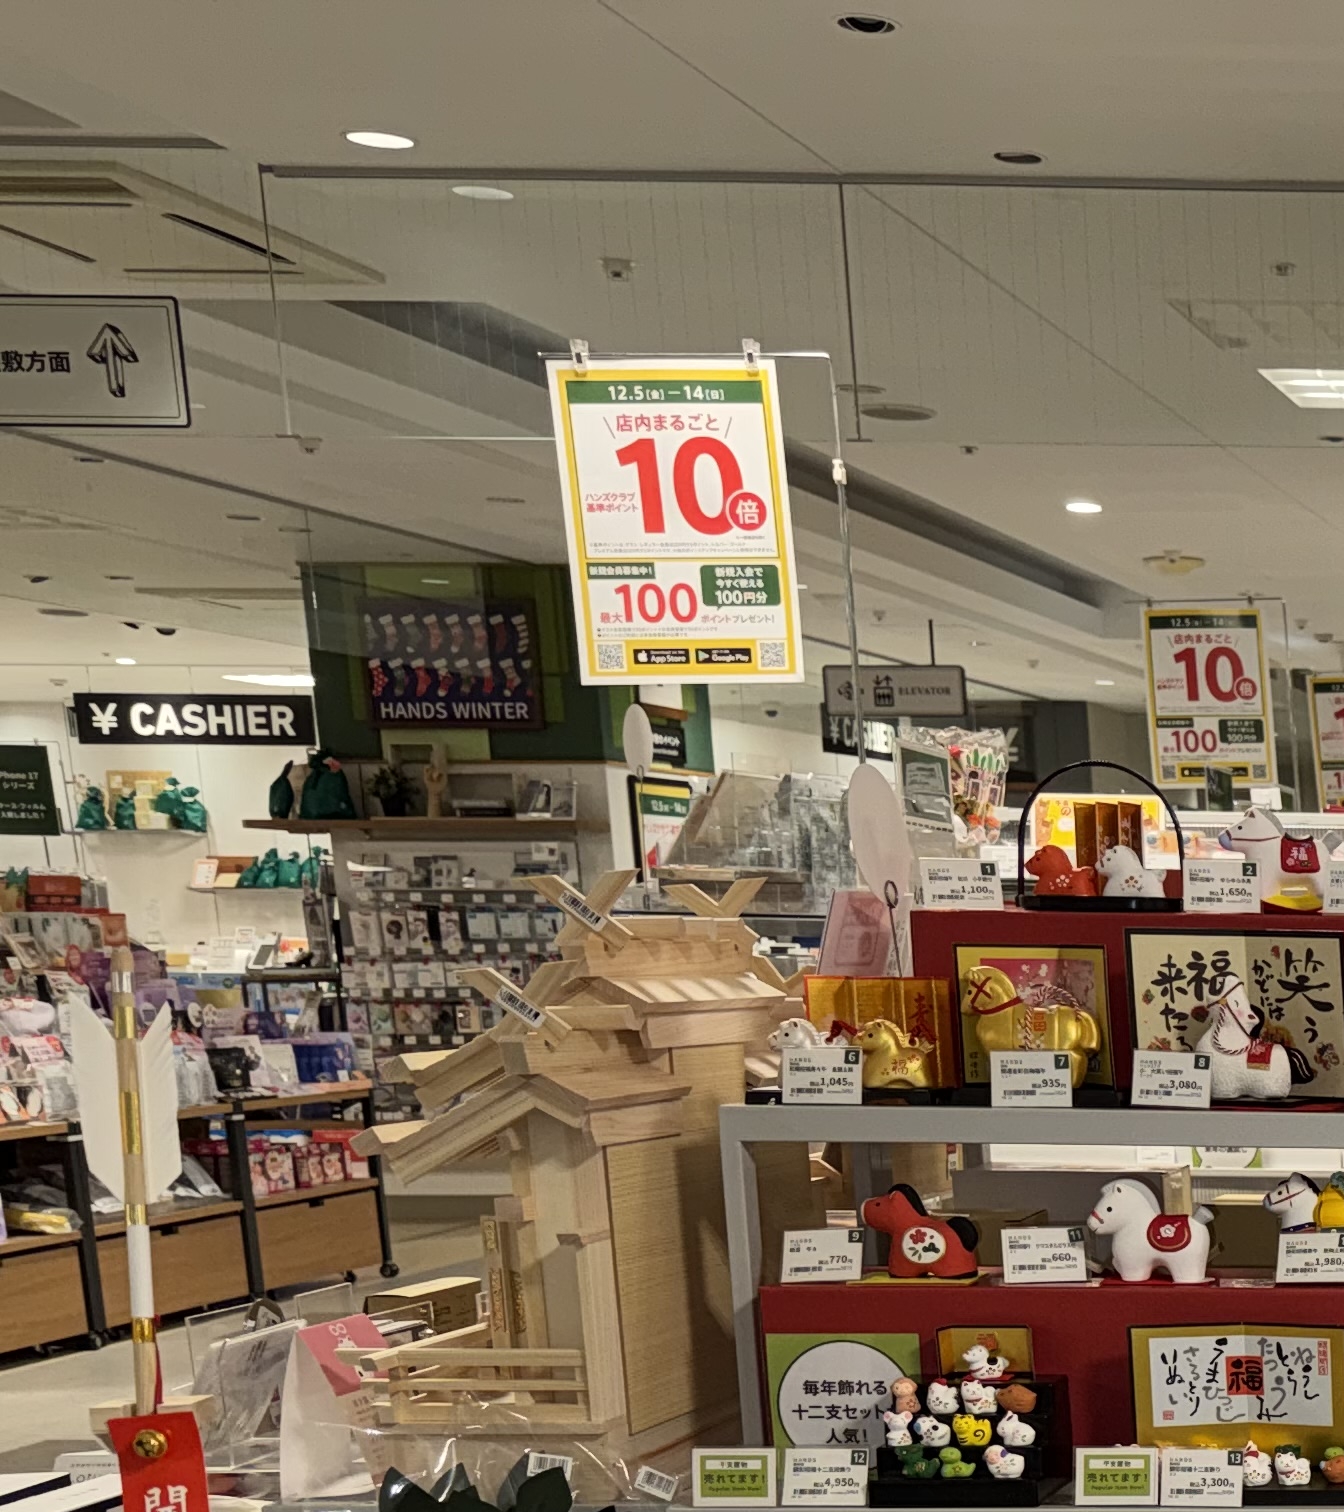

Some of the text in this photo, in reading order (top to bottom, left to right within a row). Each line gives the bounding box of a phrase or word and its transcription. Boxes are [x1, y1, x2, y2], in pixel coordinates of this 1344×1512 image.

[616, 414, 720, 432] 店内まるごと
[614, 582, 698, 623] 100
[130, 702, 297, 737] CASHIER
[380, 701, 530, 721] HANDS WINTER
[1229, 1359, 1261, 1394] 福
[803, 1380, 887, 1395] 毎年飾れる
[792, 1405, 894, 1421] 十二支セット
